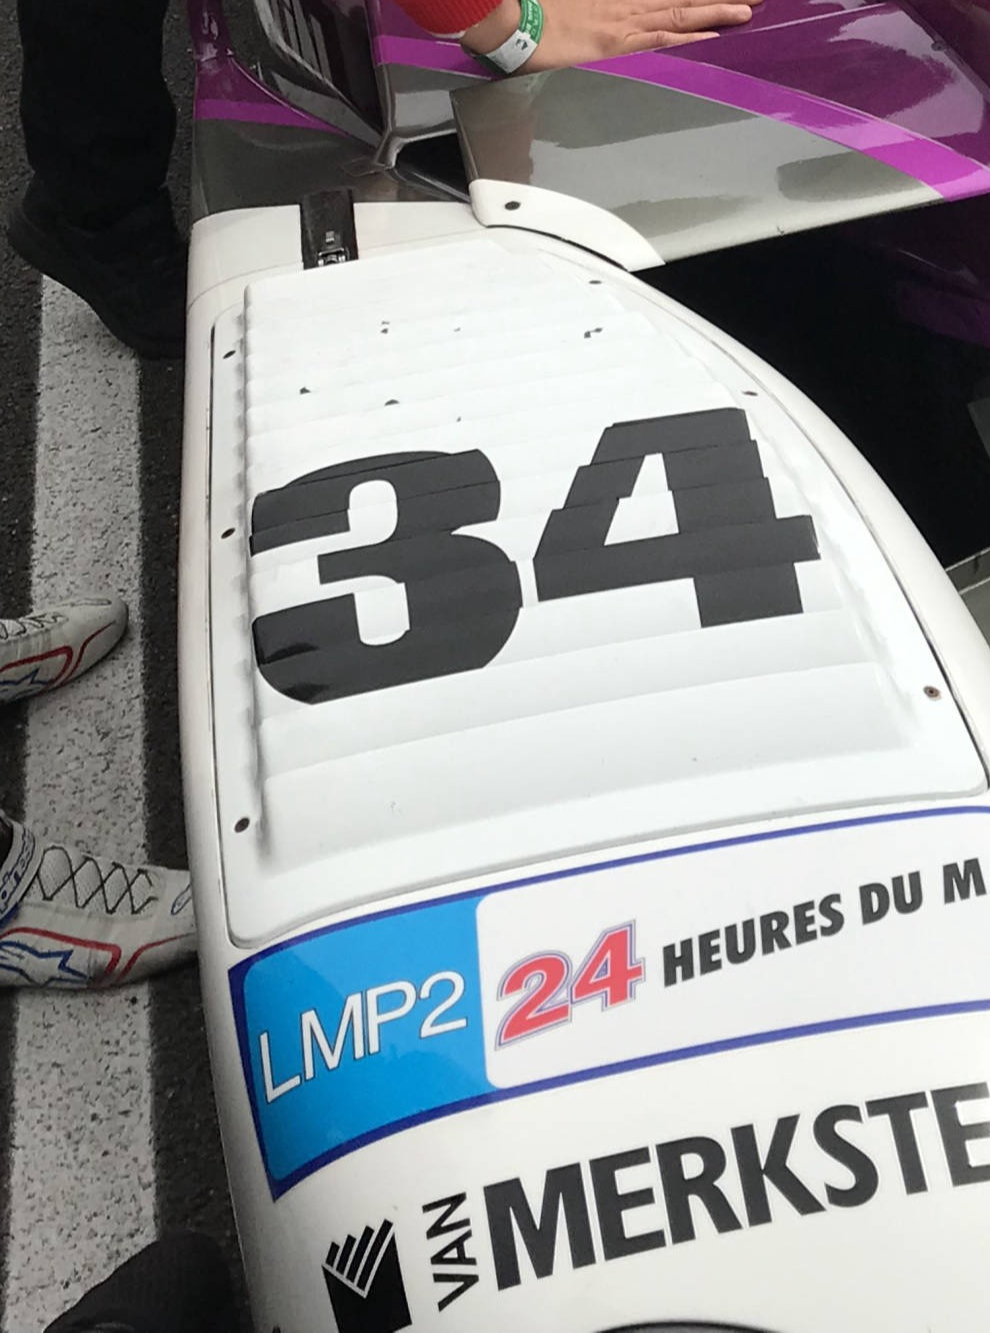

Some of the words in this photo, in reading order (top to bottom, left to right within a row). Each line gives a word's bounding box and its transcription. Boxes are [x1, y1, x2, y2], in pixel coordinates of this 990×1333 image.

[247, 408, 822, 706] 34
[259, 970, 470, 1105] LMP2
[494, 920, 648, 1050] 24
[662, 892, 847, 988] HEURES
[858, 870, 925, 926] DU
[422, 1191, 480, 1312] VAN
